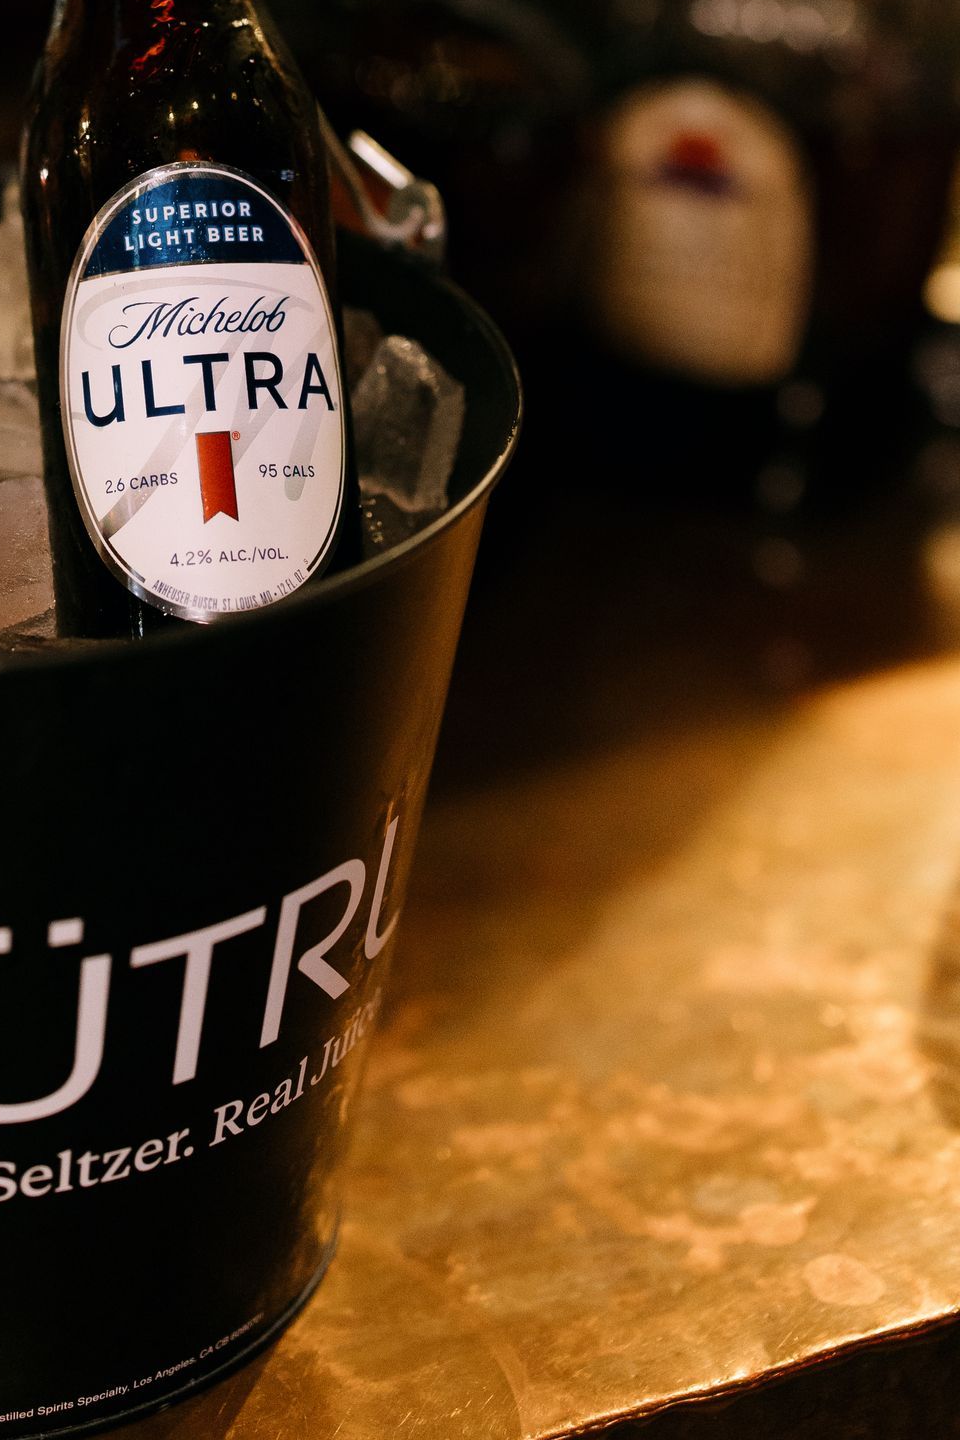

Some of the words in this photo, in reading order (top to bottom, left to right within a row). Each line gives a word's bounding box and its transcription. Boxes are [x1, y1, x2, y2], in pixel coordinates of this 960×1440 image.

[132, 202, 252, 225] SUPERIOR
[124, 228, 195, 251] LIGHT
[207, 226, 264, 242] BEER
[108, 295, 290, 349] Michelob
[81, 351, 336, 427] ULTRA
[105, 479, 125, 494] 2.6
[129, 472, 179, 490] CARBS
[258, 464, 278, 478] 95
[282, 464, 315, 478] CALS
[170, 549, 213, 567] 4.2%
[218, 546, 289, 563] ALC./VOL.
[208, 1055, 309, 1147] Real
[37, 1400, 74, 1416] Spirits
[76, 1384, 130, 1407] Specialty,
[133, 1375, 153, 1389] Los
